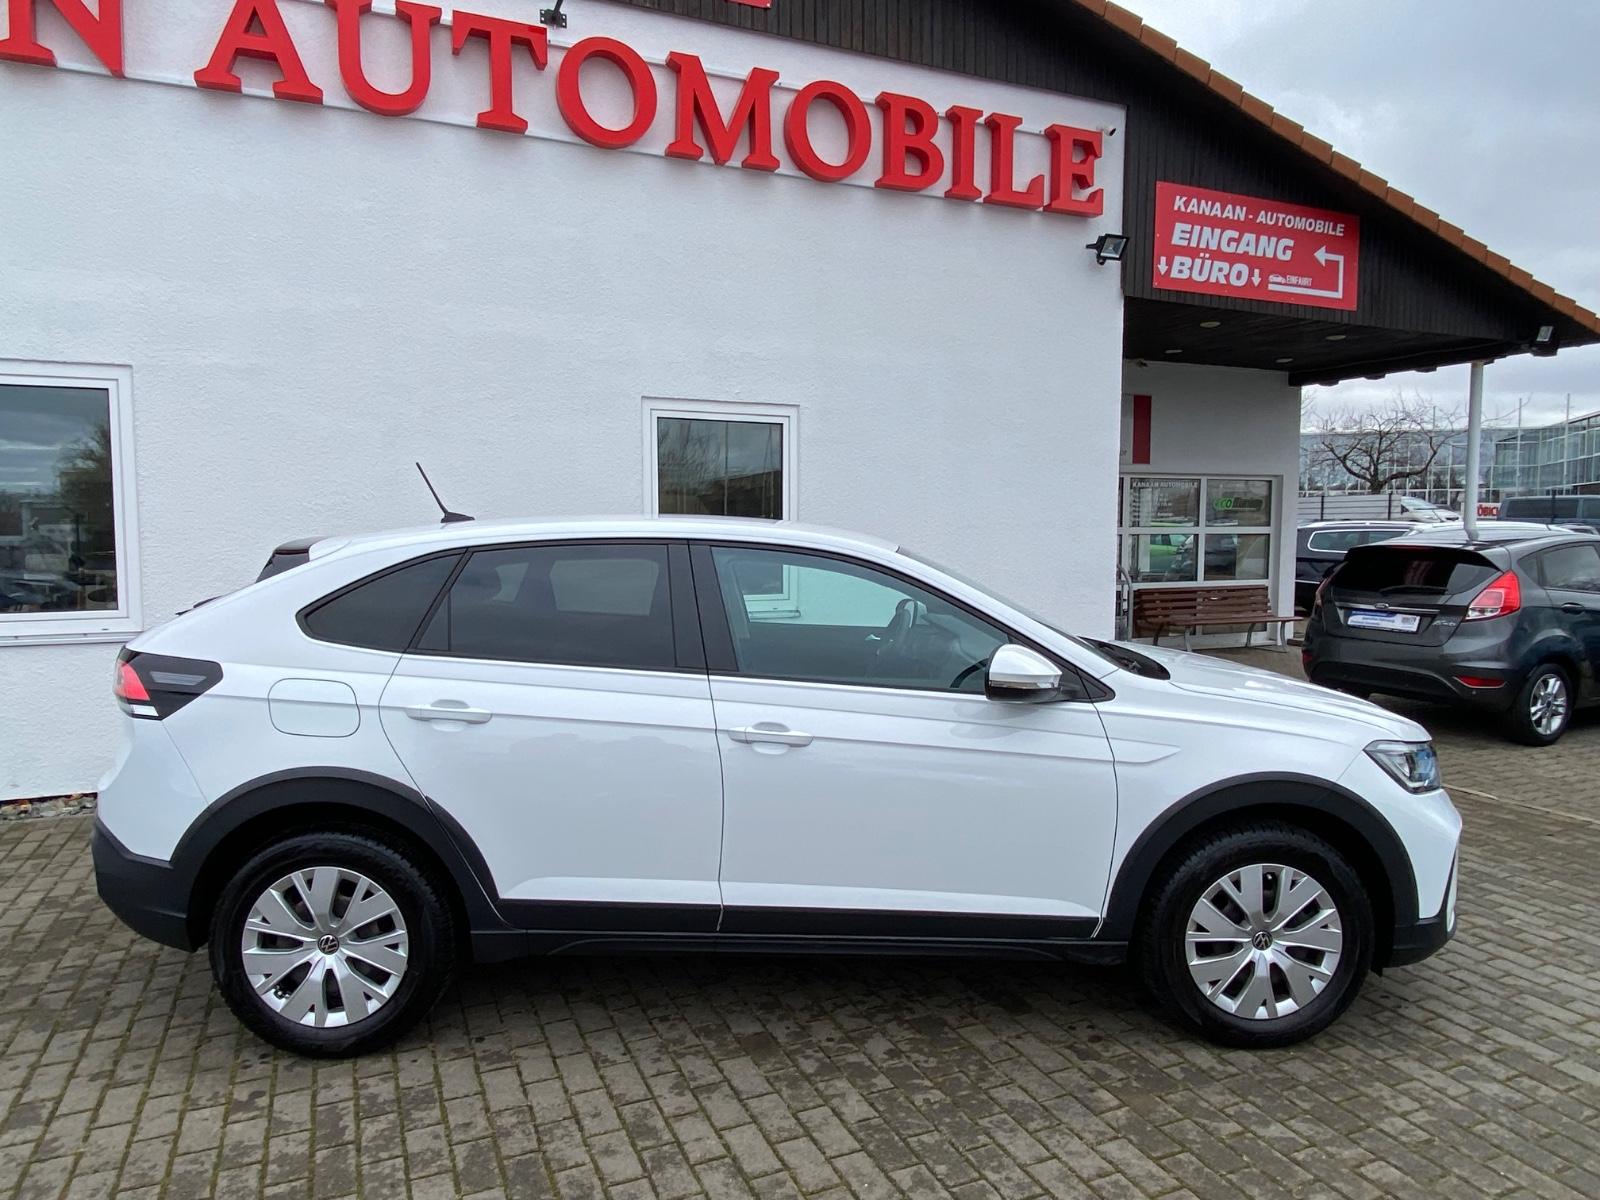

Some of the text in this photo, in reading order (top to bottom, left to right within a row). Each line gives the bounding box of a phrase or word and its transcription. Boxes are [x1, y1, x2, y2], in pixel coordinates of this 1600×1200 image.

[194, 0, 1104, 217] AUTOMOBILE
[1173, 195, 1247, 221] KANAAN
[1256, 210, 1344, 236] AUTOMOBILE
[1171, 222, 1295, 261] EINGANG
[1170, 252, 1250, 287] BÜRO
